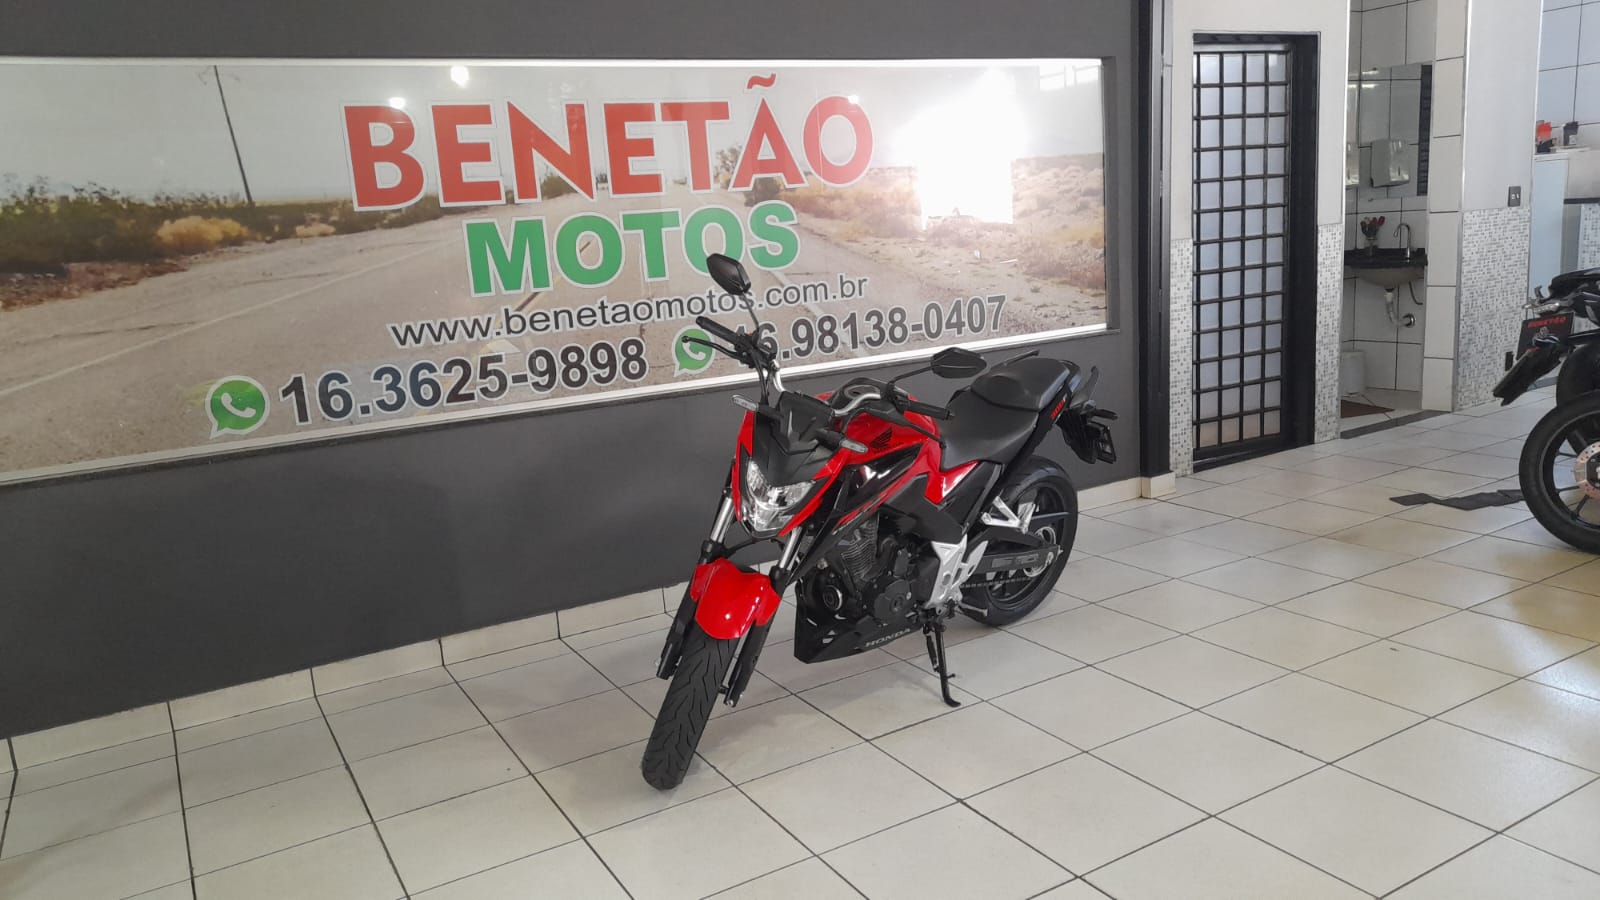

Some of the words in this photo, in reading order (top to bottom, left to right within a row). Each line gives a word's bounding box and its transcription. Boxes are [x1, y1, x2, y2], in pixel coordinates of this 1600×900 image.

[342, 73, 875, 208] BENETÃO
[465, 202, 800, 294] MOTOS
[390, 274, 868, 346] www.benetaomotos.com.br
[280, 338, 648, 423] 16.3625-9898
[866, 628, 911, 647] HONDA
